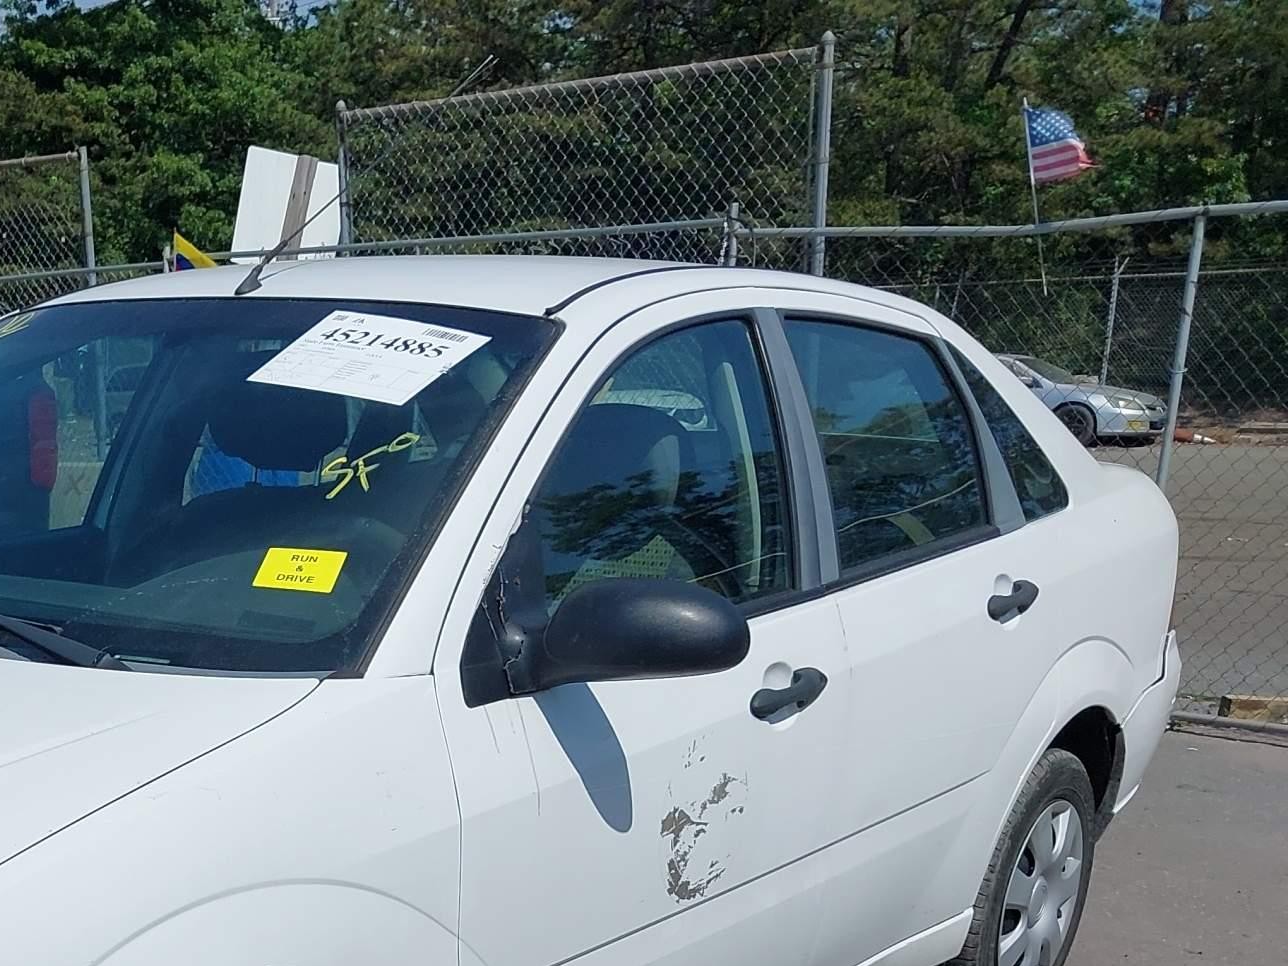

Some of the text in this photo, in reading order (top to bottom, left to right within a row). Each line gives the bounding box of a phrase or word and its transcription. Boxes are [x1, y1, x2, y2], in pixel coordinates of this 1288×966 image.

[320, 327, 451, 359] 45214885
[290, 554, 319, 563] RUN
[275, 573, 316, 584] DRIVE
